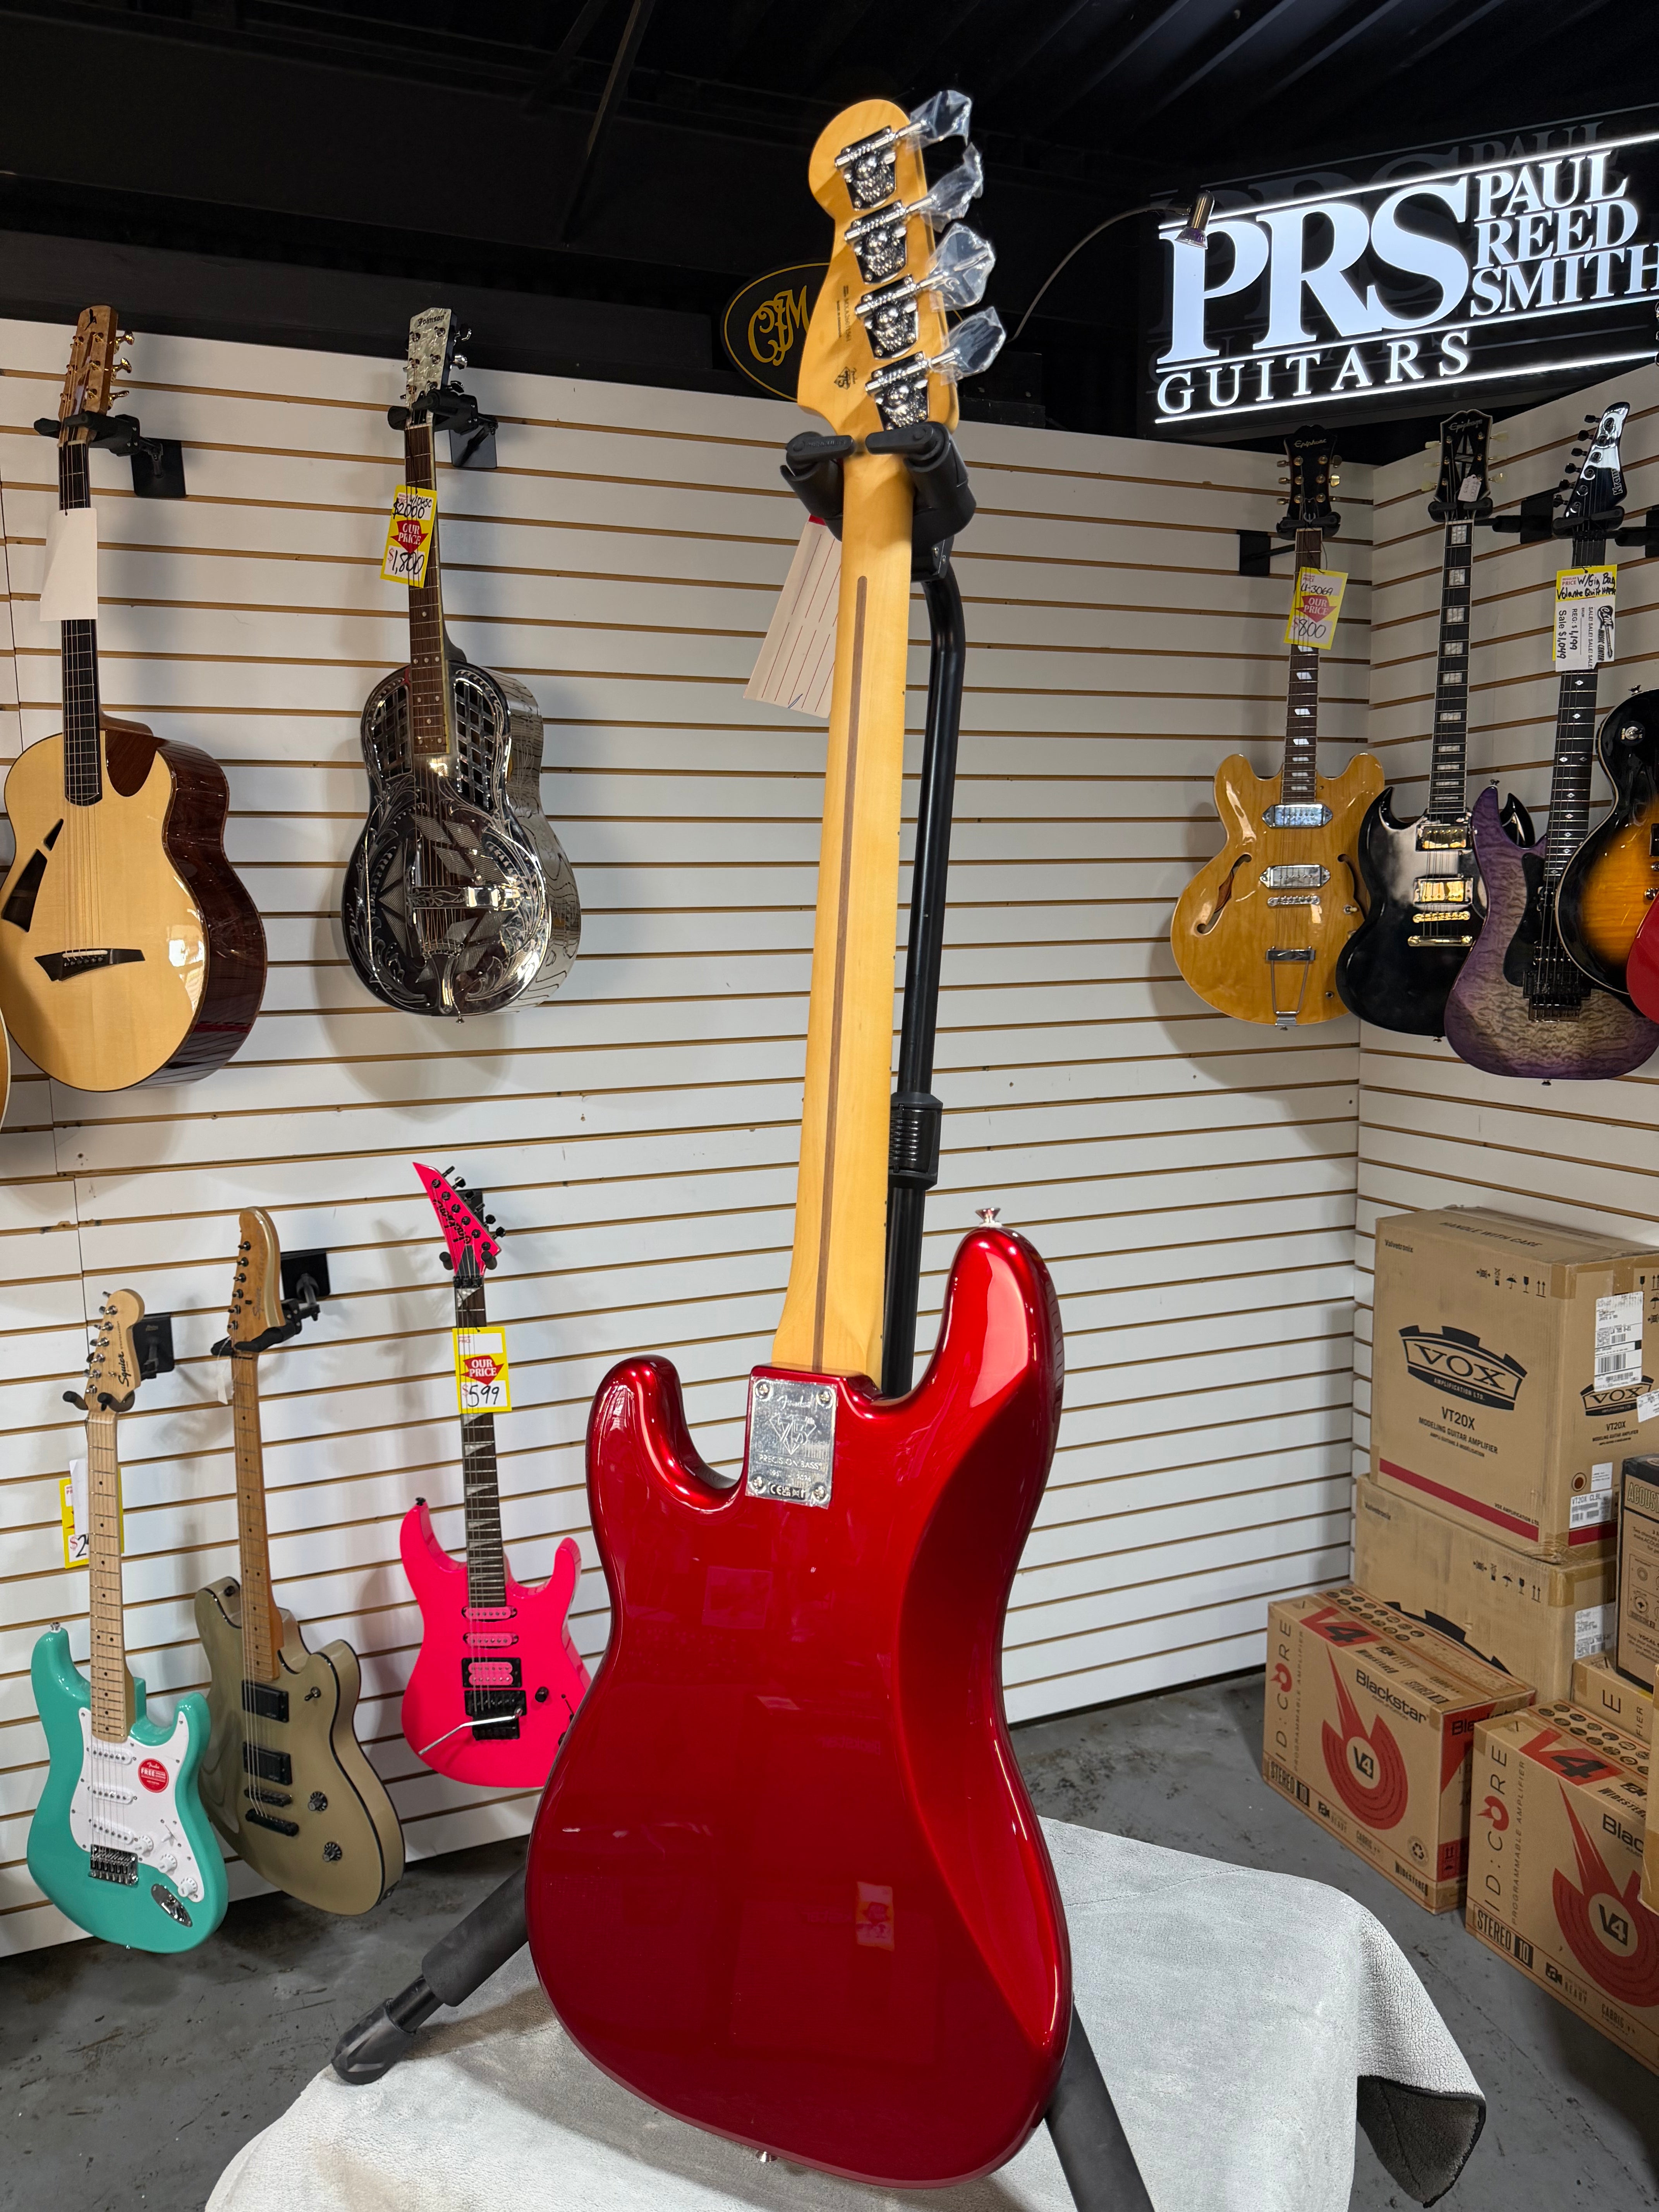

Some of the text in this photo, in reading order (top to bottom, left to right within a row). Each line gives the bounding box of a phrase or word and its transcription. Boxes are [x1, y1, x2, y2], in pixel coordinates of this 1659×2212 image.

[1475, 151, 1627, 223] PAUL
[1473, 199, 1639, 270] REED
[1158, 174, 1470, 364] PRS
[1470, 242, 1659, 318] SMITH
[417, 315, 444, 327] Johnson
[1156, 328, 1470, 415] GUITARS
[398, 532, 421, 545] PRICE
[402, 523, 420, 534] OUR
[388, 548, 425, 575] $1,800
[1304, 606, 1328, 616] PRICE
[1308, 598, 1327, 607] OUR
[1292, 617, 1326, 639] $800
[1557, 610, 1567, 659] Sale $1,049
[1510, 1238, 1543, 1248] CARE
[118, 1351, 131, 1387] Squier
[469, 1368, 497, 1377] PRICE
[472, 1359, 493, 1368] OUR
[1414, 1343, 1505, 1391] VOX
[462, 1384, 500, 1408] $599
[1590, 1387, 1643, 1403] VOX
[1442, 1407, 1475, 1431] VT20X
[1606, 1420, 1626, 1431] VT20X
[1419, 1417, 1498, 1454] MODELING GUITAR AMPLIFIER
[70, 1534, 89, 1558] $2
[1356, 1668, 1426, 1723] Blackstar
[141, 1768, 155, 1777] FREE
[1512, 1829, 1522, 1925] PROGRAMMABLE
[1477, 1910, 1511, 1951] STEREO
[1599, 1903, 1628, 1946] V4
